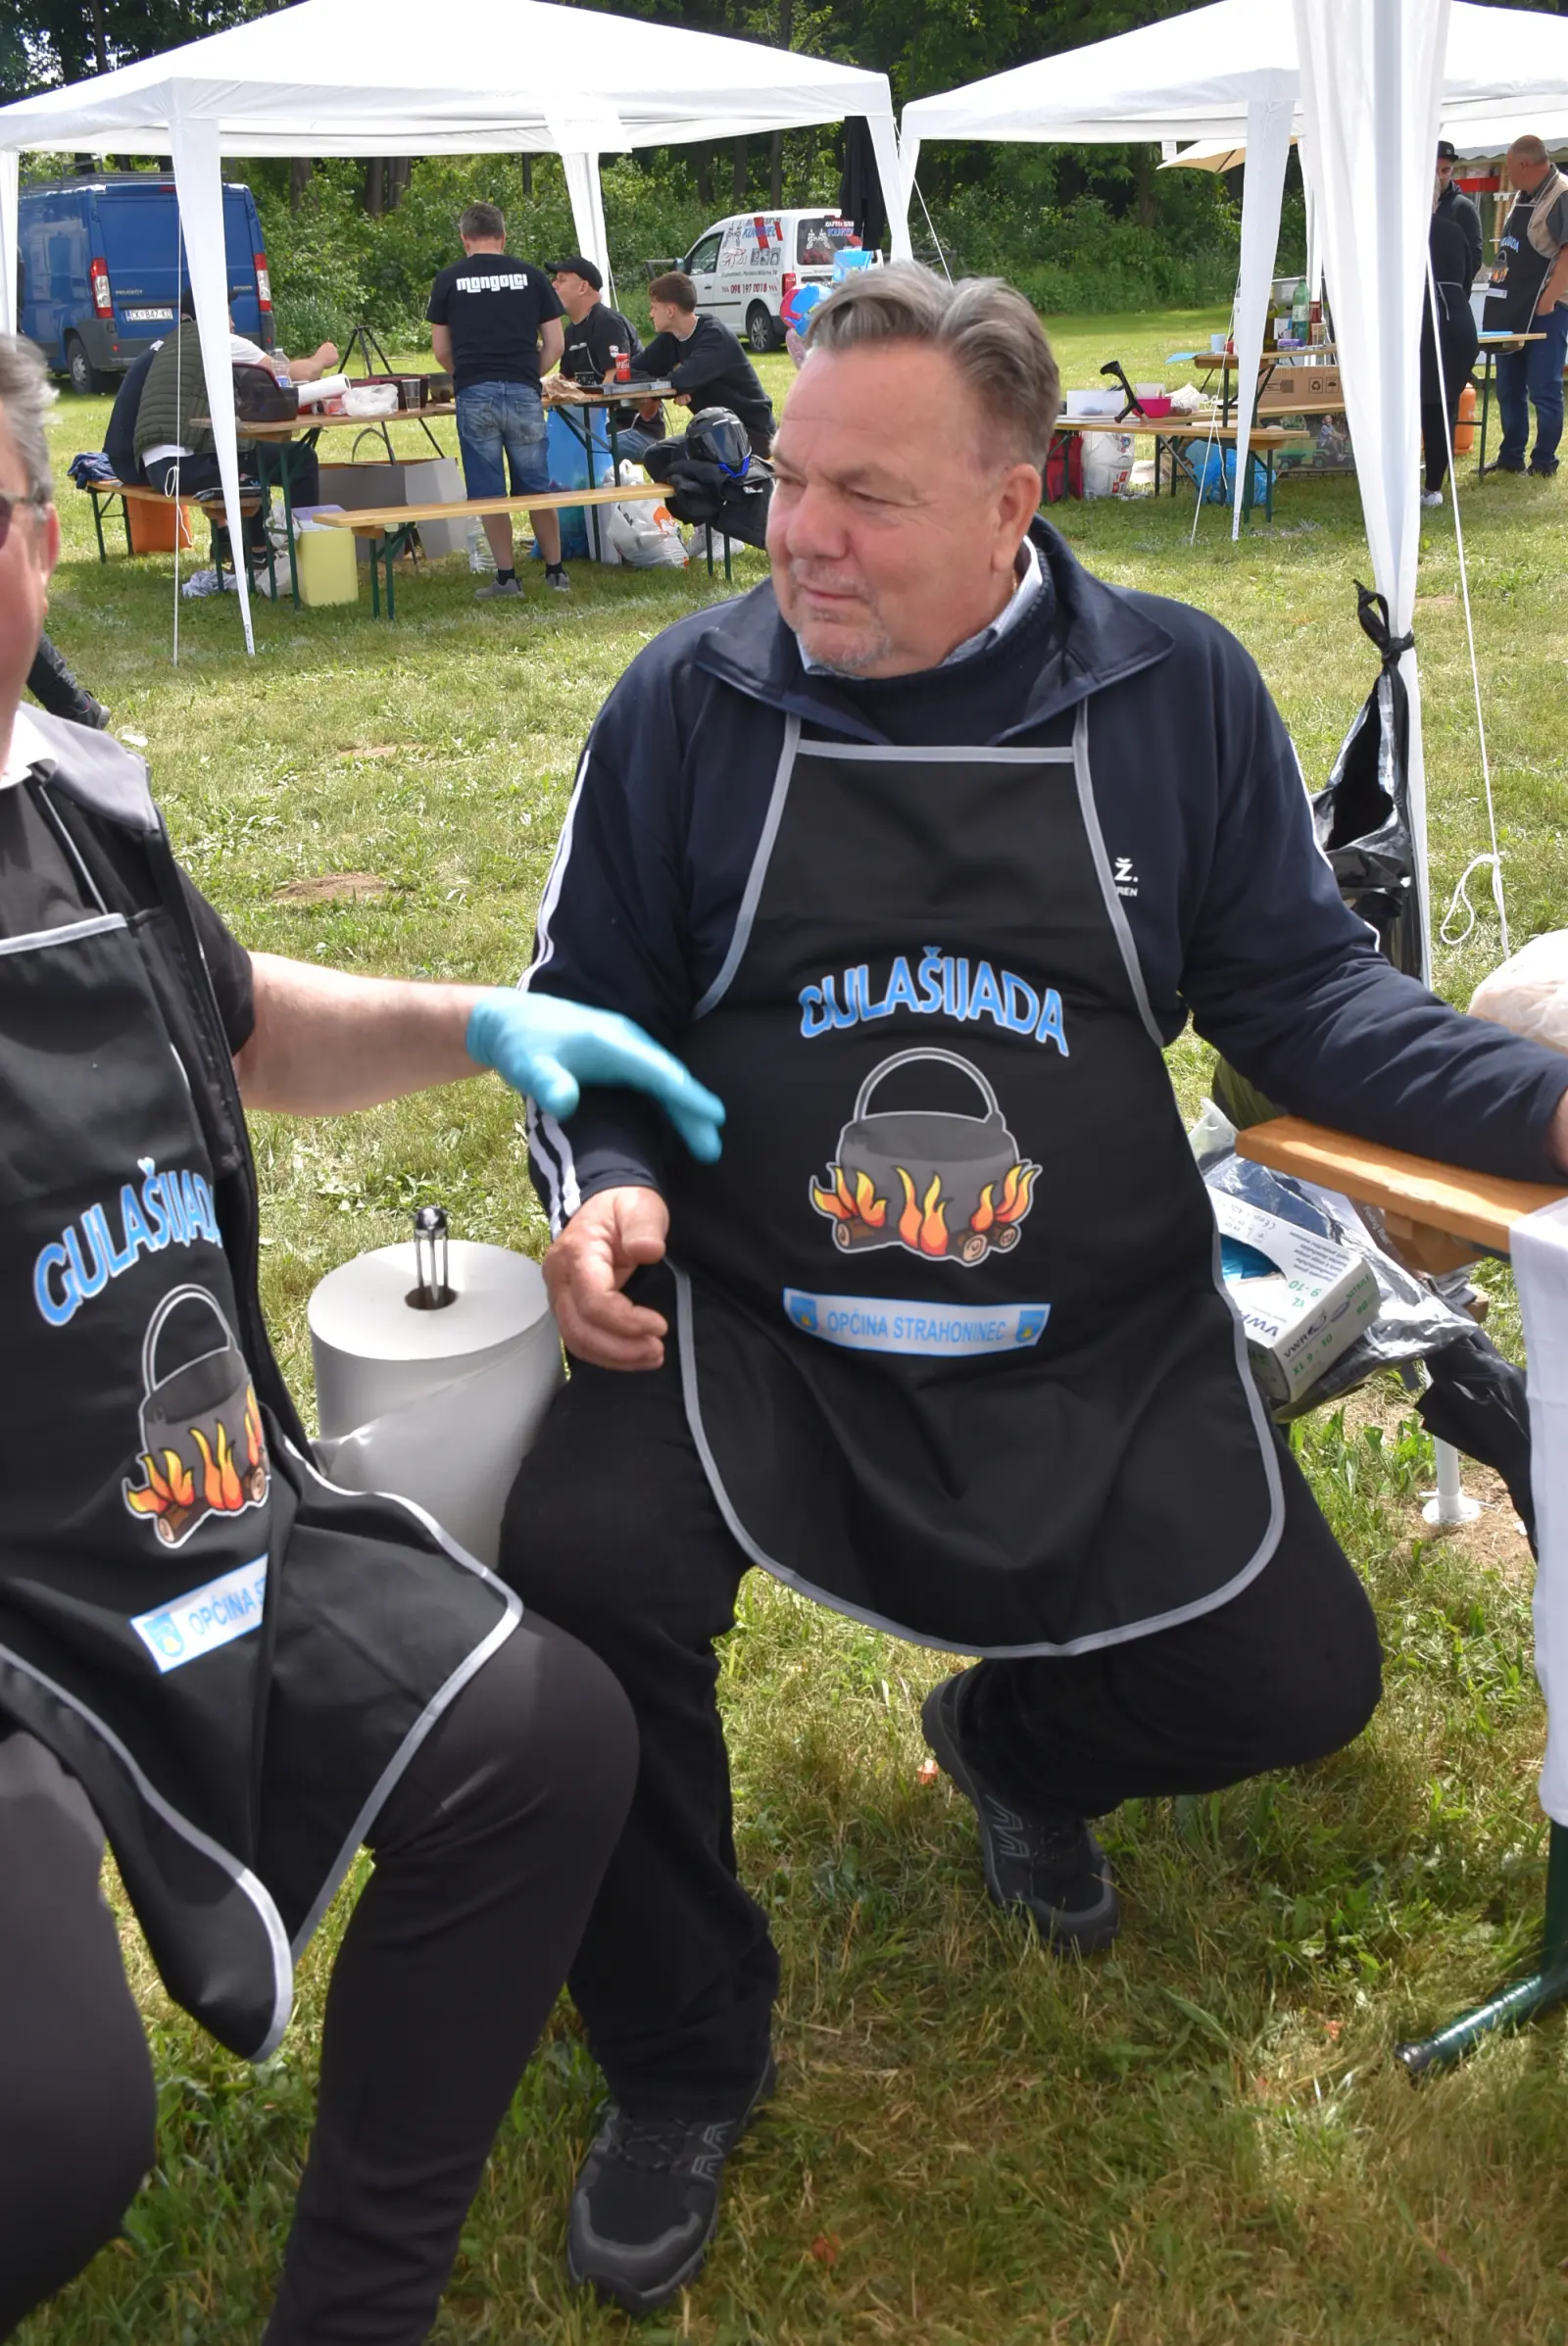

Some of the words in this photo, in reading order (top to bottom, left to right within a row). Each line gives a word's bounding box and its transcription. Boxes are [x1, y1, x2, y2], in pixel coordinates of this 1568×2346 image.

[33, 1156, 223, 1326] GULAŠIJAD
[826, 1307, 888, 1338] OPĆINA
[892, 1316, 1007, 1344] STRAHONINEC
[188, 1586, 257, 1636] OPĆINA
